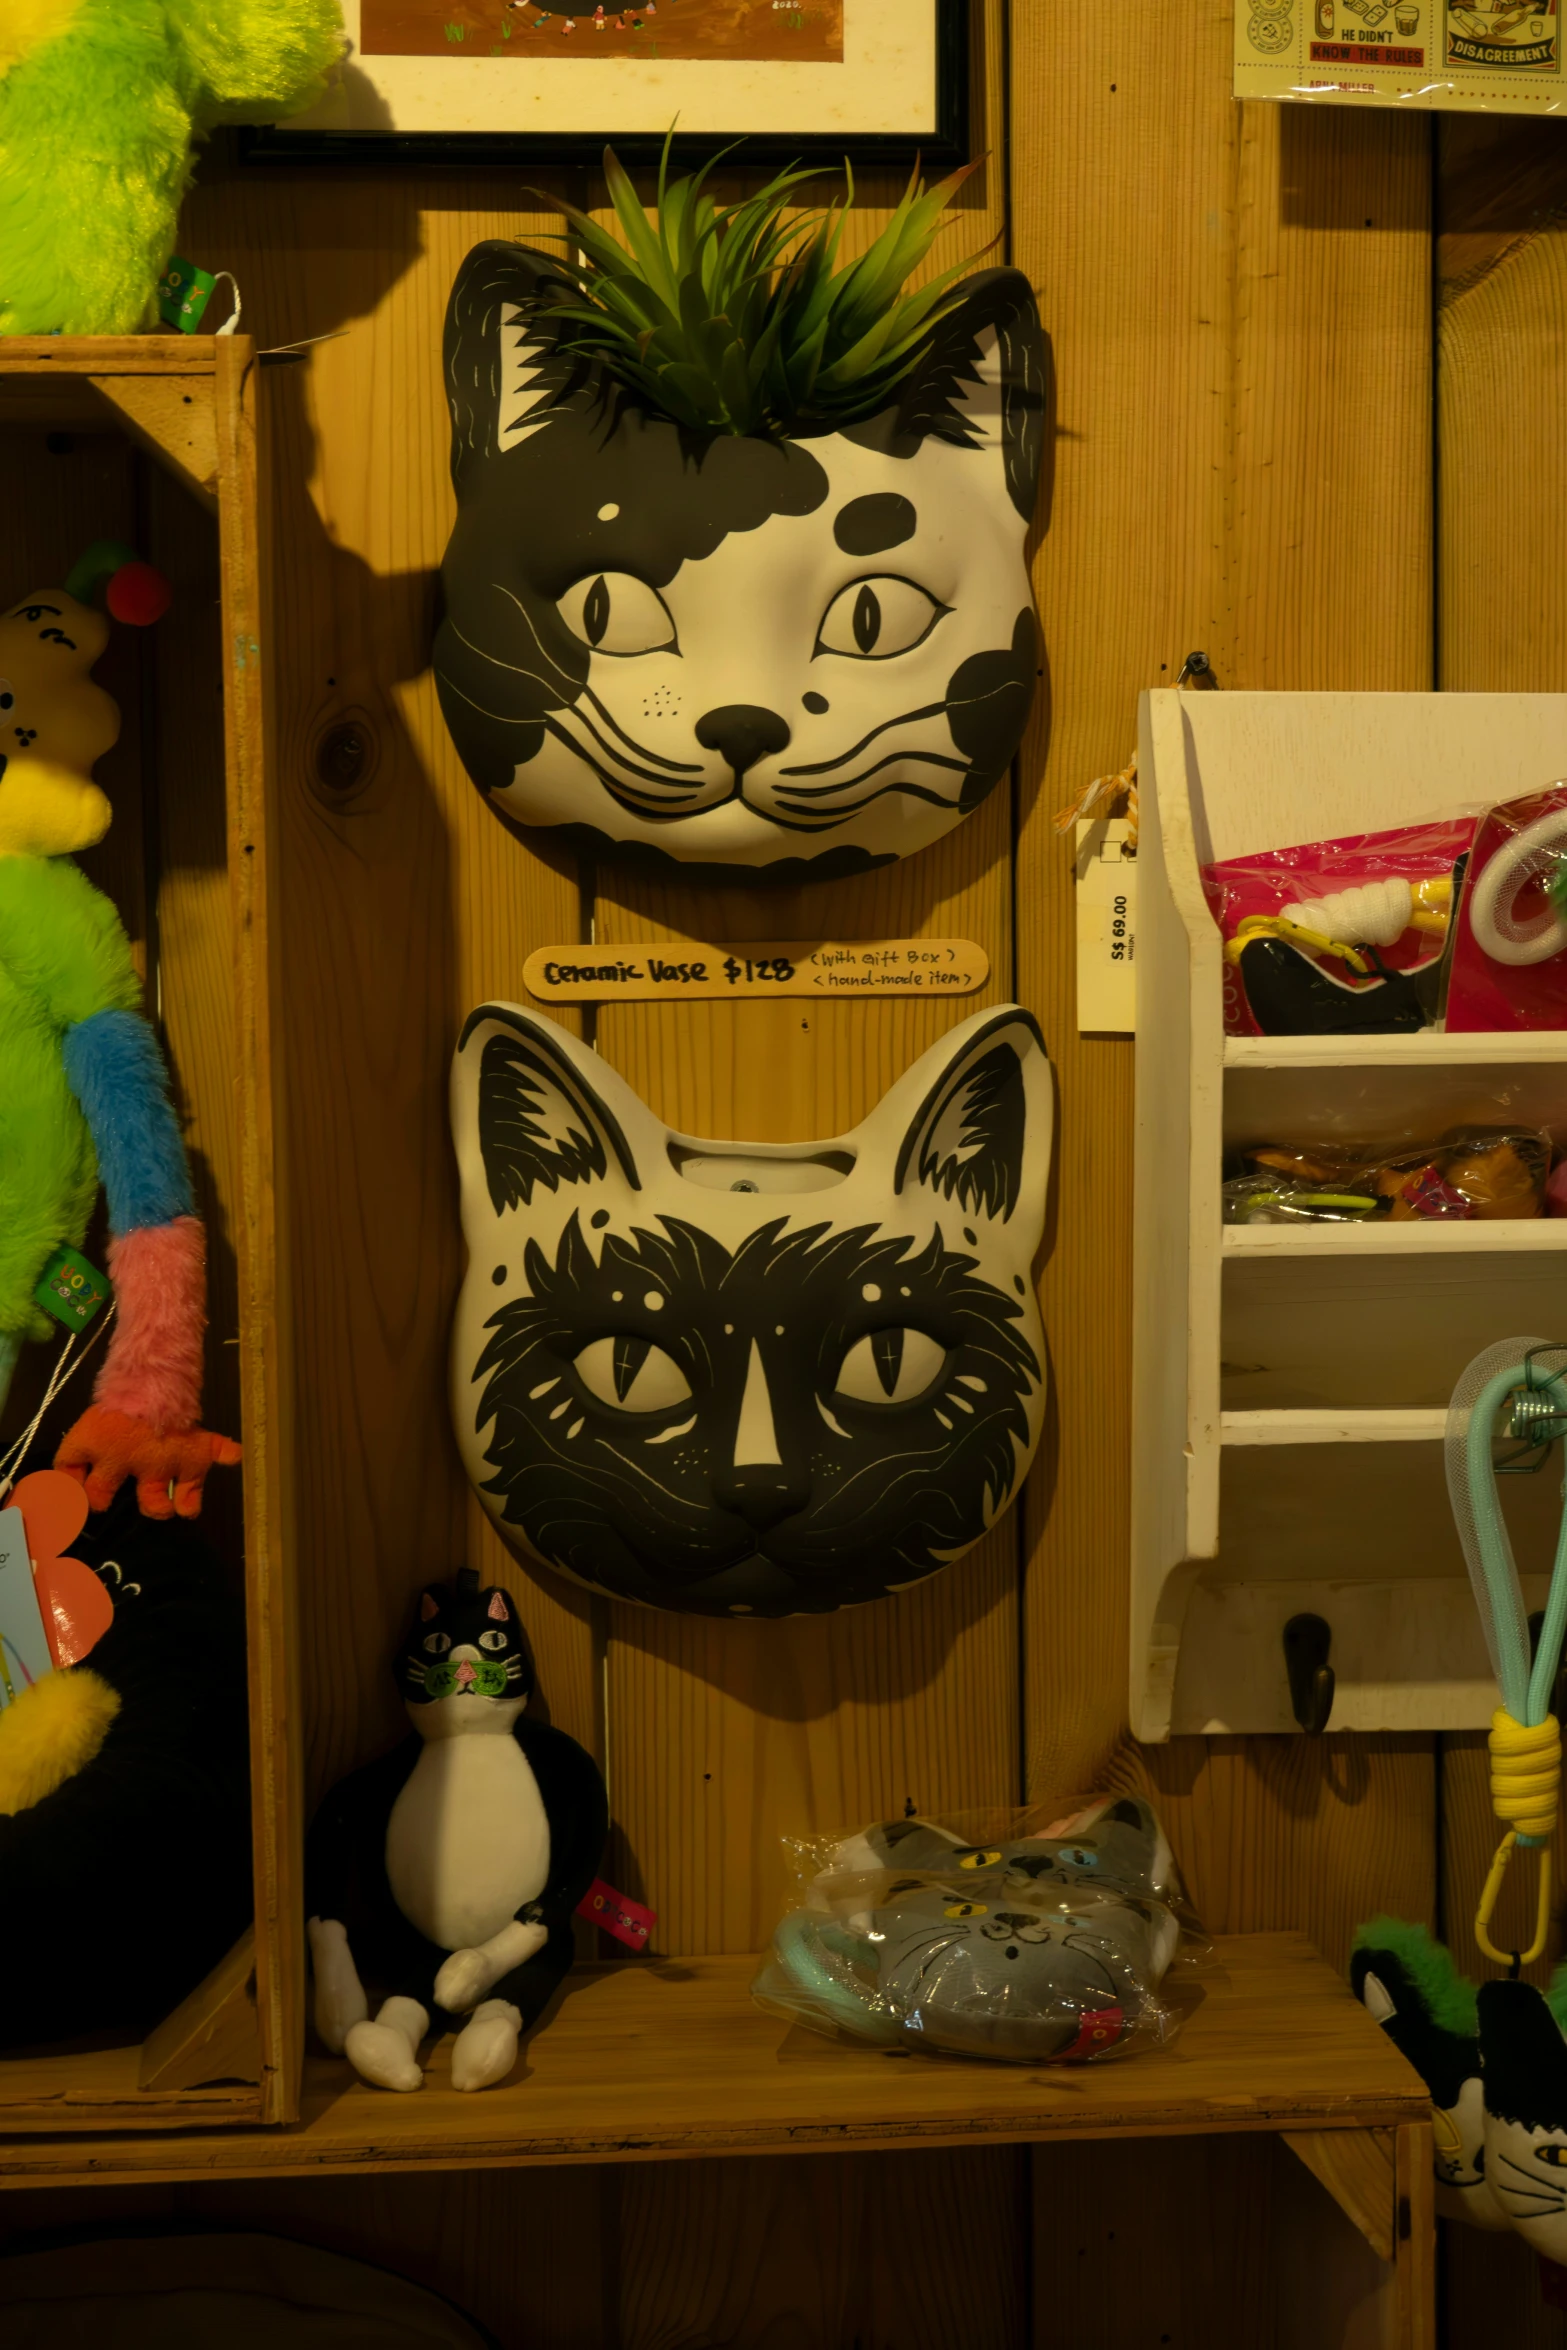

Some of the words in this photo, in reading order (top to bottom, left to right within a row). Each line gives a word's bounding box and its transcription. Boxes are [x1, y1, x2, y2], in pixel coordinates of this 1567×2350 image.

[1342, 29, 1355, 41] HE
[1358, 30, 1393, 43] DIDN'T
[1312, 46, 1351, 59] KNOW
[1358, 48, 1379, 61] THE
[1385, 49, 1422, 63] RULES
[1454, 40, 1549, 62] DISAGREEMENT
[1112, 896, 1127, 938] 69.00
[1111, 942, 1127, 961] S$
[544, 961, 644, 985] Ceramic
[648, 959, 709, 983] Vase
[723, 957, 795, 984] $128
